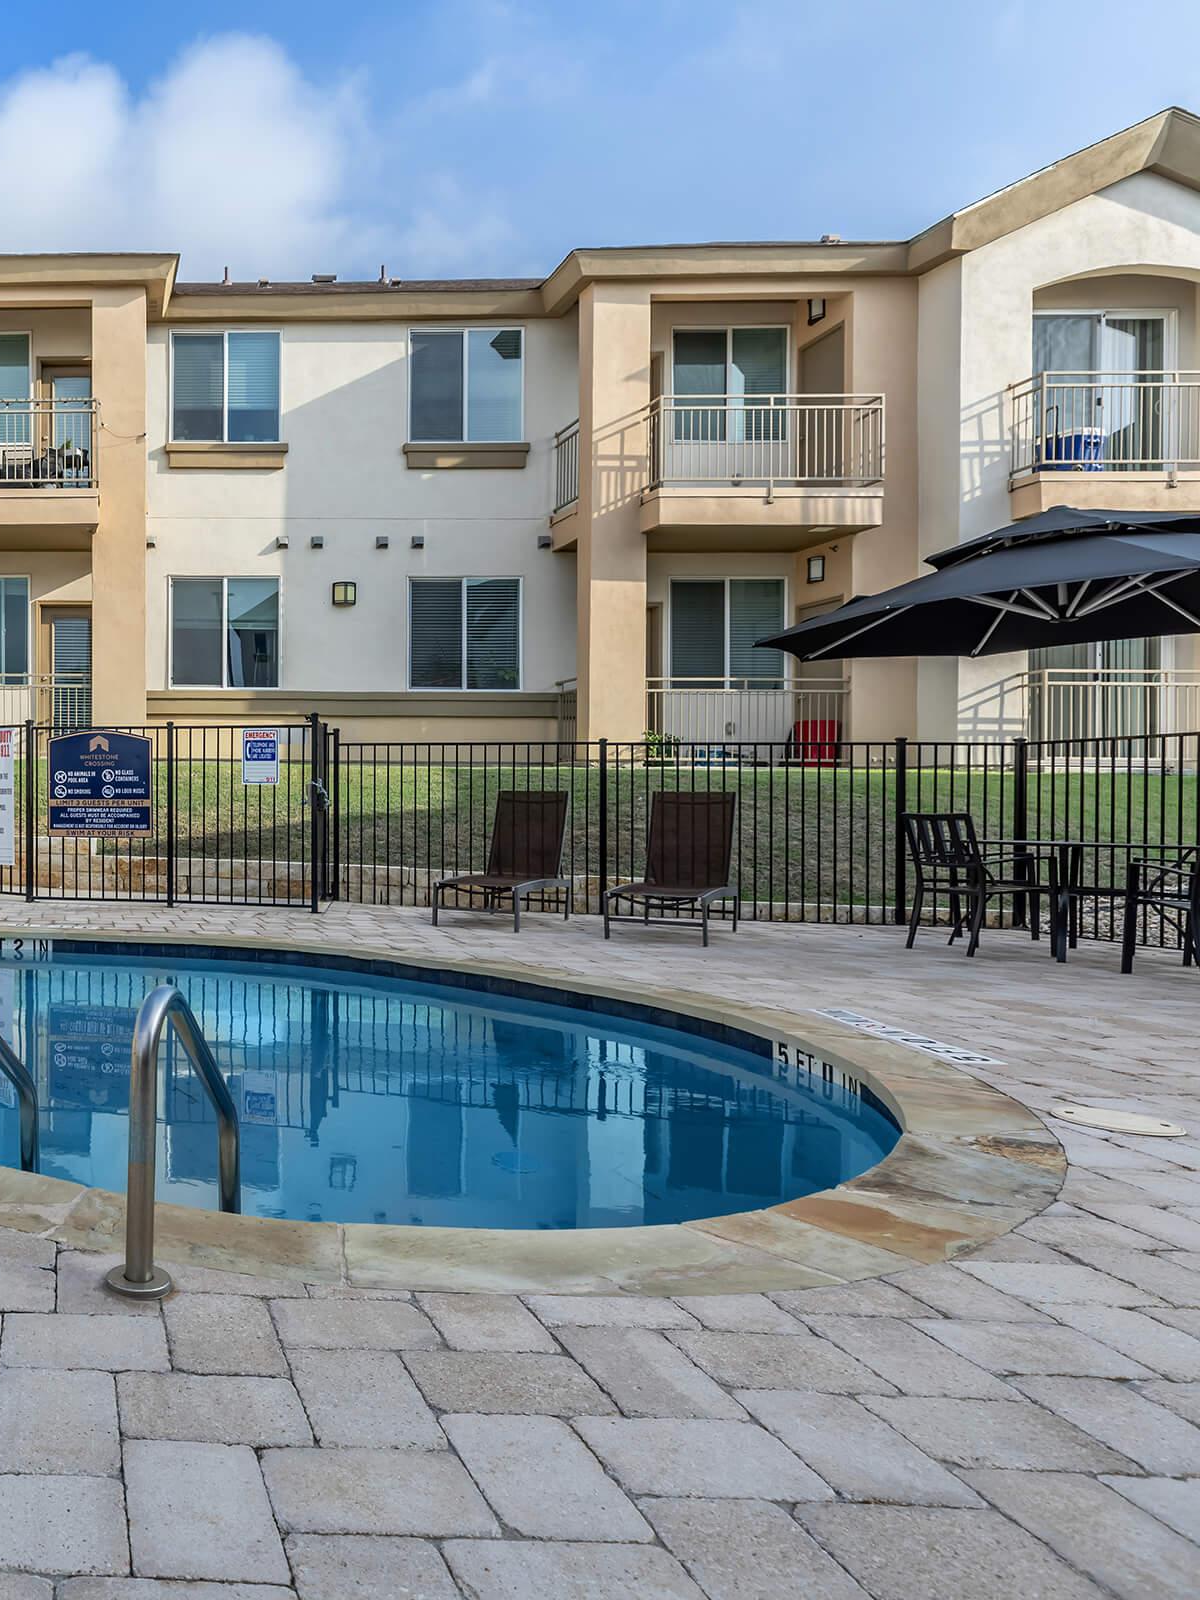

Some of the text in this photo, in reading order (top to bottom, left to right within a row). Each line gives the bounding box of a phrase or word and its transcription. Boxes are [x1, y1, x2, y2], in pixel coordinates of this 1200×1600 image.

[0, 730, 12, 743] DUTY
[32, 940, 49, 952] IN
[777, 1041, 789, 1065] 5
[796, 1048, 815, 1074] FT
[842, 1072, 860, 1097] IN
